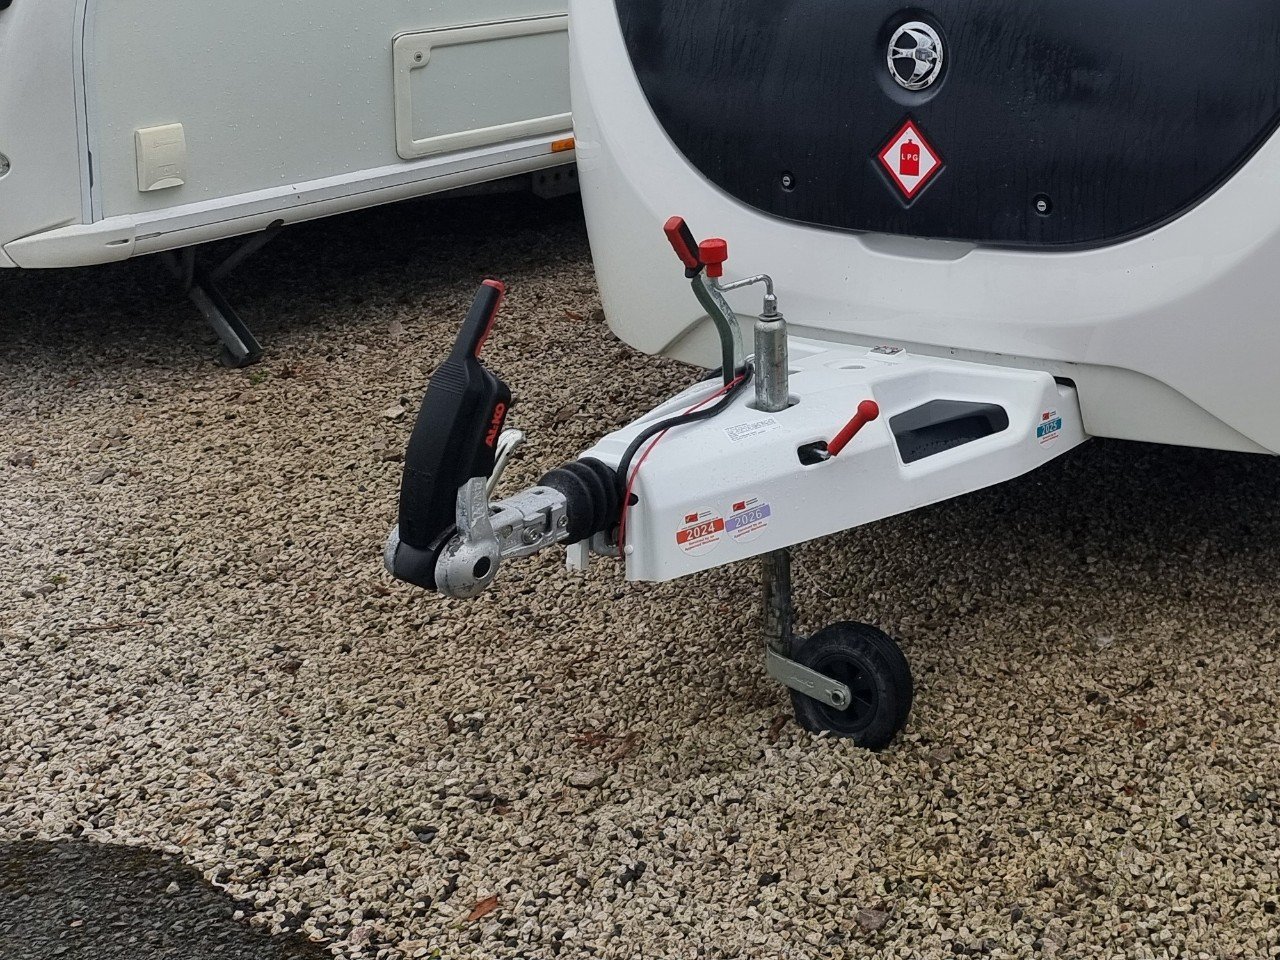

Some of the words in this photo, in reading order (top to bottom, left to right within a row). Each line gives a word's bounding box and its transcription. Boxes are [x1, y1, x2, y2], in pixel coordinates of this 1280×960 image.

[901, 153, 919, 162] LPG
[1041, 421, 1058, 435] 2025
[734, 510, 763, 528] 2026
[686, 522, 716, 541] 2024
